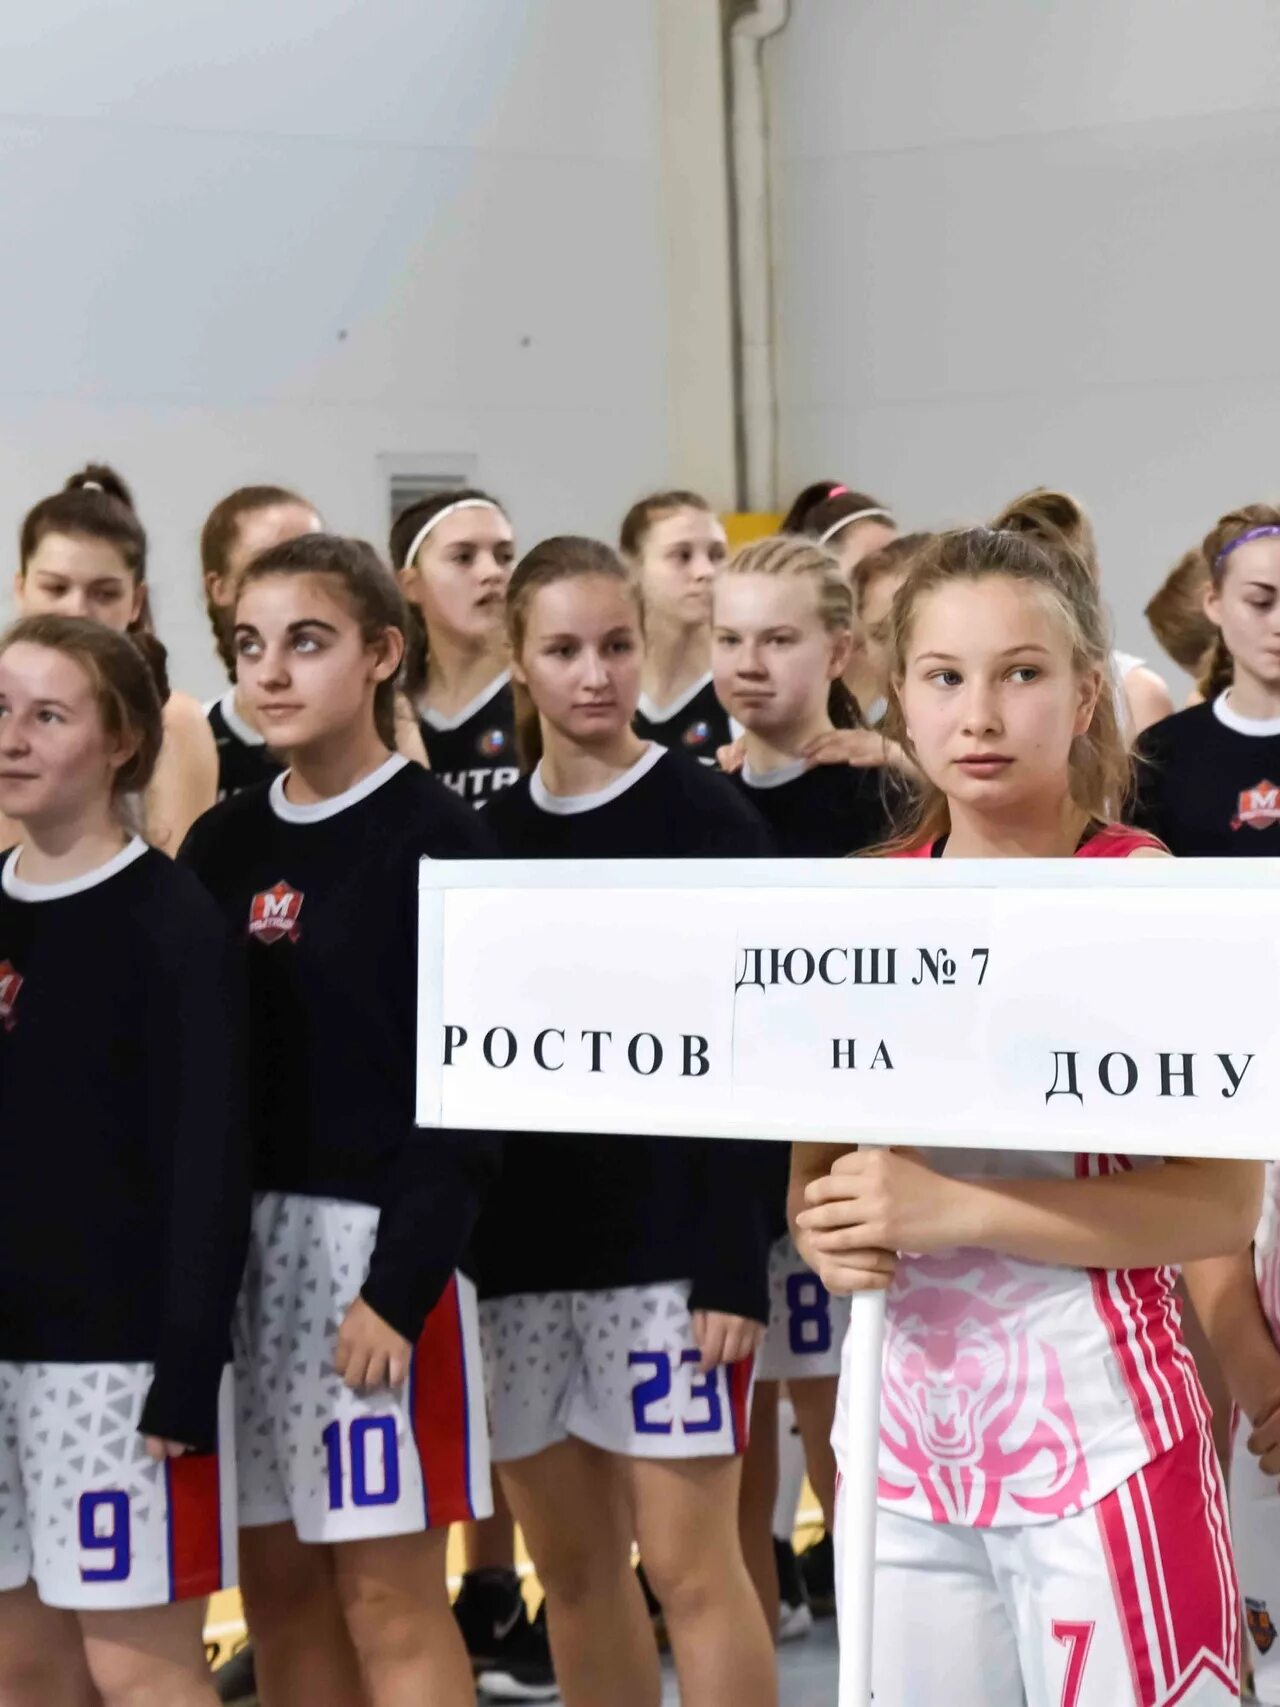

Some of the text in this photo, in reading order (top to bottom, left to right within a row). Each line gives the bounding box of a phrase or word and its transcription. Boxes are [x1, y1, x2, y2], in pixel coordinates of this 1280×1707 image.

[734, 947, 990, 995] ДЮСШ № 7
[442, 1025, 1256, 1107] РОСТОВ НА ДОНУ
[786, 1271, 832, 1355] 8
[628, 1349, 723, 1435] 23
[322, 1414, 402, 1511] 10
[78, 1488, 131, 1583] 9
[1051, 1619, 1096, 1707] 7
